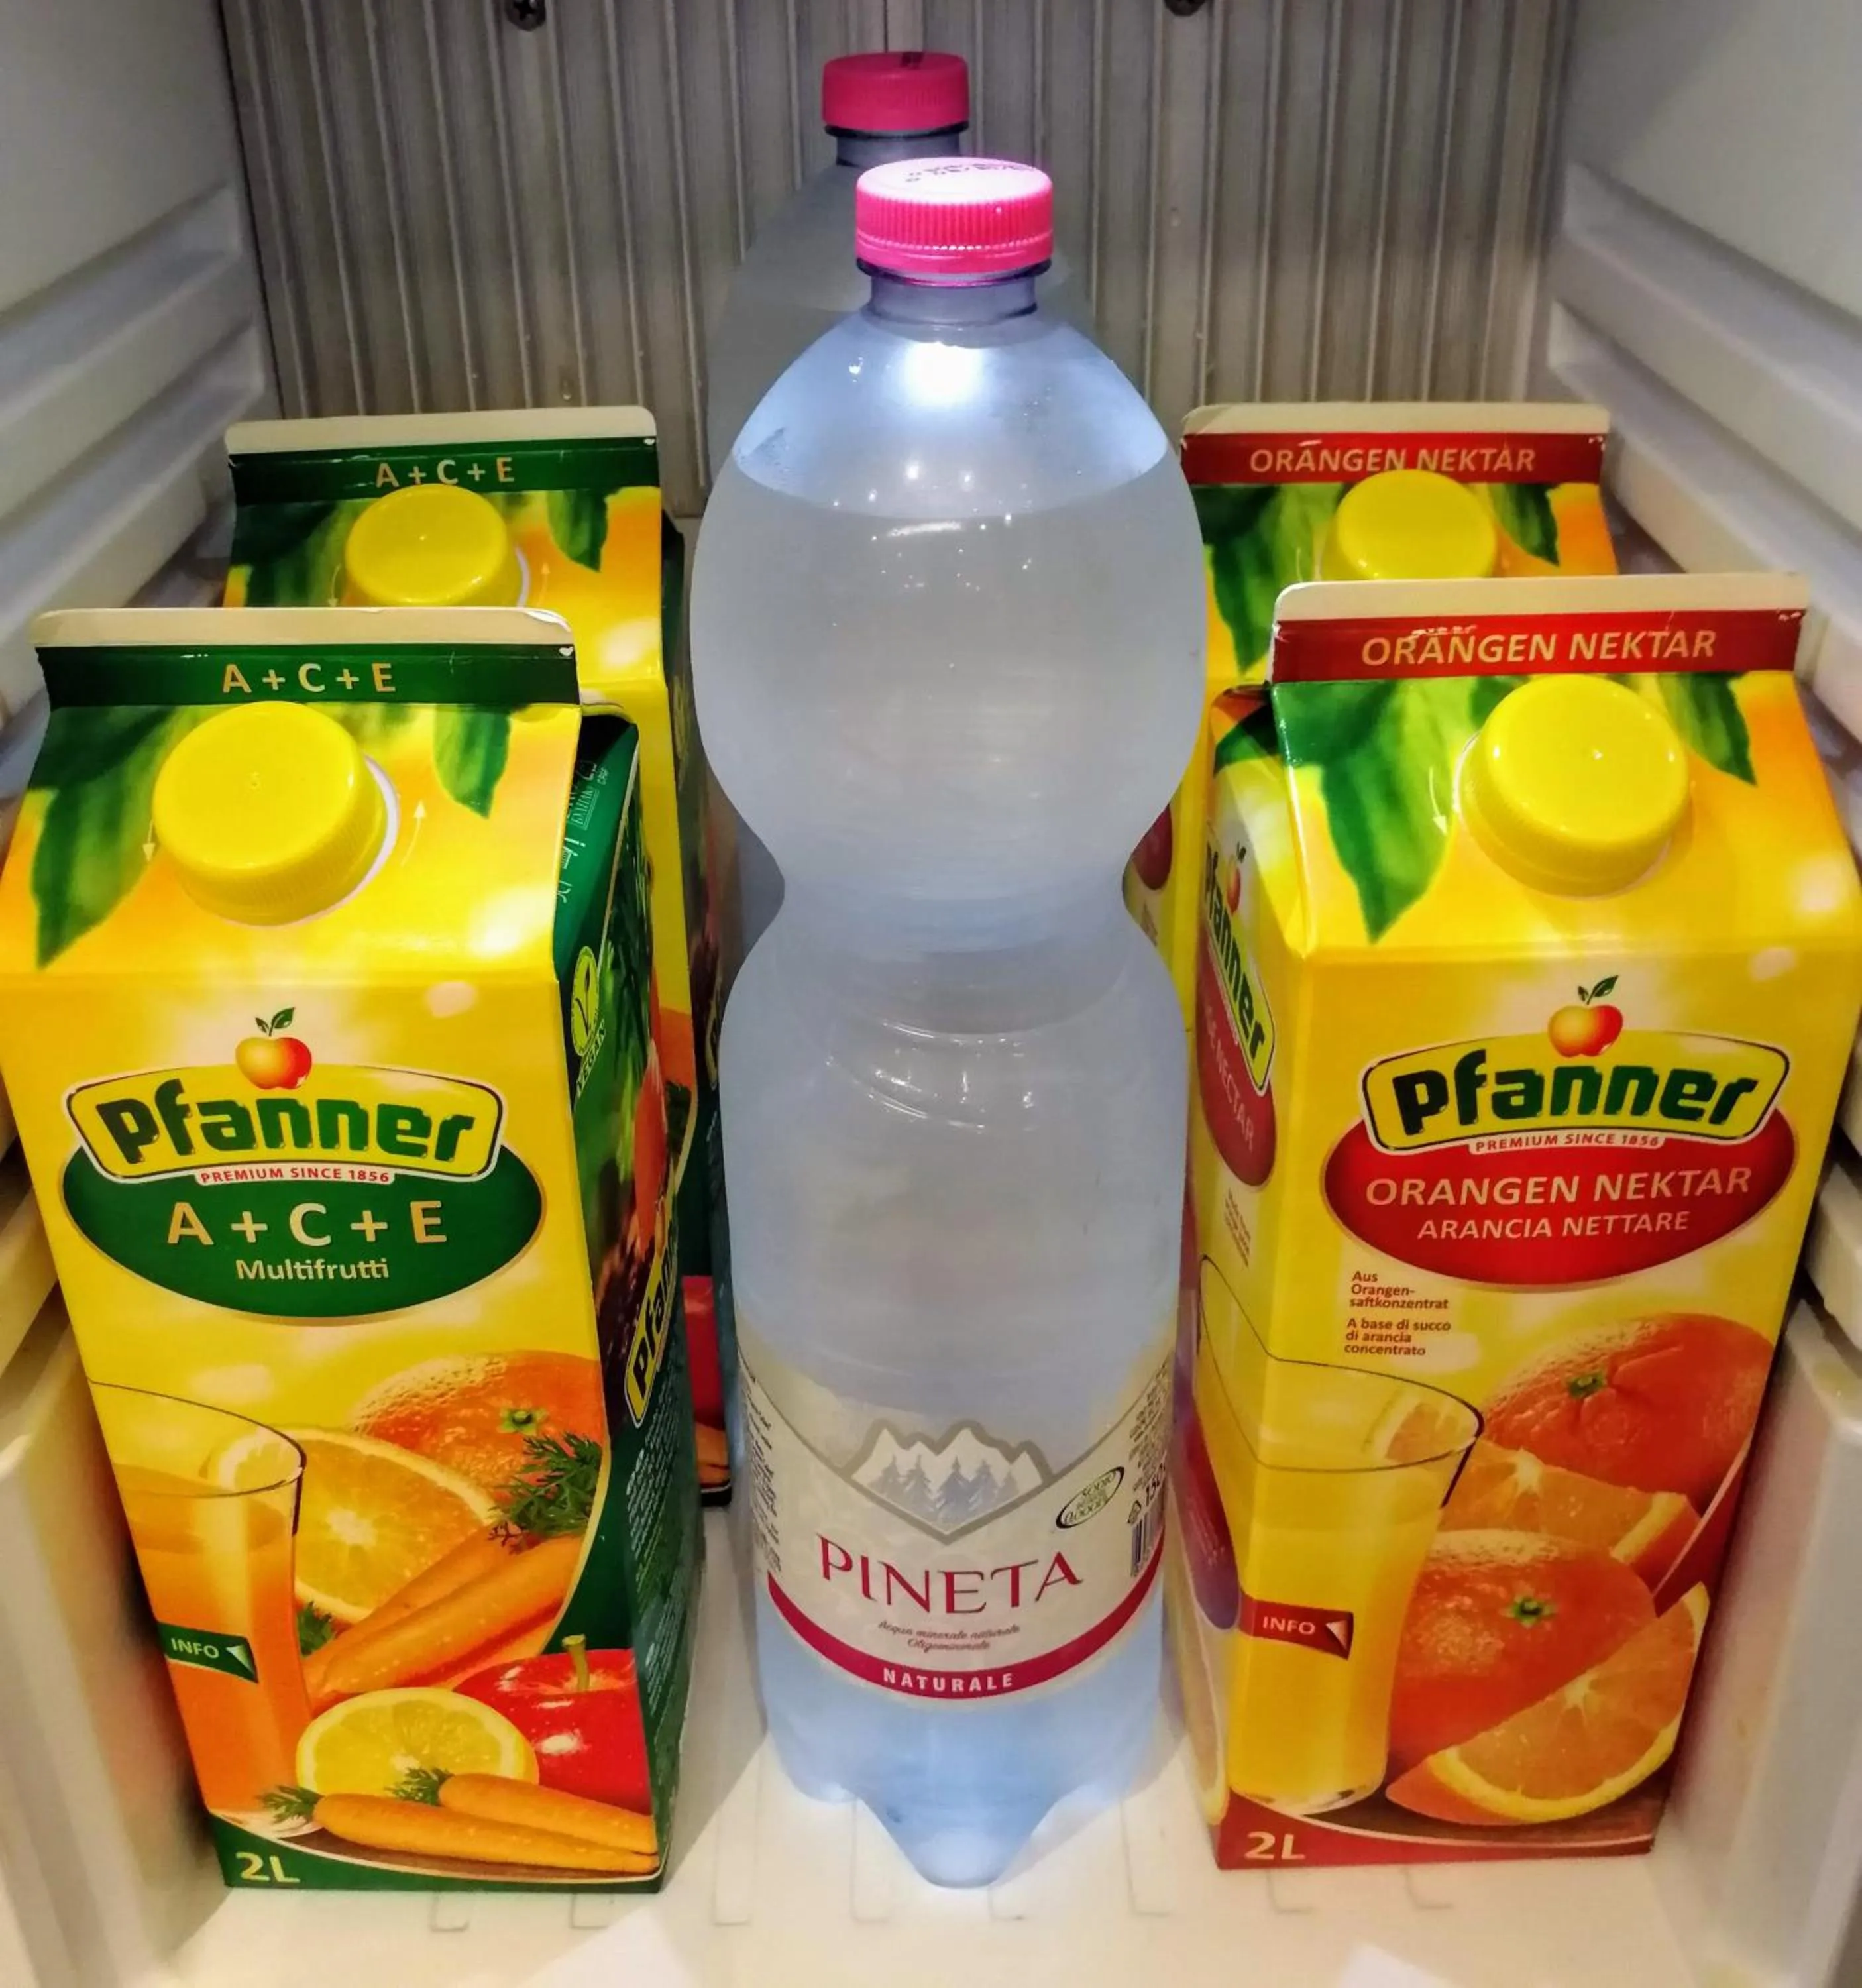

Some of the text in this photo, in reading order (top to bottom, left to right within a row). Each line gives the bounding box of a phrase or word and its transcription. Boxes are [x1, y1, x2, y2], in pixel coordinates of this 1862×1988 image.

[1250, 448, 1536, 472] ORANGEN NEKTAR
[1362, 629, 1716, 666] ORANGEN NEKTAR
[1392, 1048, 1759, 1136] Pfanner
[95, 1077, 476, 1165] Pfanner
[1476, 1133, 1660, 1152] PREMIUM SINCE 1856
[201, 1168, 390, 1183] PREMIUM SINCE 1856
[1366, 1166, 1752, 1206] ORANGEN NEKTAR
[1417, 1210, 1690, 1240] ARANCIA NETTARE
[235, 1258, 390, 1280] Multifrutti
[1352, 1270, 1378, 1282] Aus
[1351, 1283, 1415, 1299] Orangen-
[1349, 1297, 1449, 1309] saftkonzentrat
[1346, 1317, 1452, 1331] A base di succo
[1346, 1330, 1412, 1343] di arancia
[1344, 1344, 1427, 1356] concentrato
[816, 1533, 1083, 1614] PINETA
[1262, 1616, 1316, 1635] INFO
[171, 1637, 220, 1658] INFO
[883, 1667, 1014, 1693] NATURALE
[1245, 1832, 1306, 1861] 2L
[235, 1851, 301, 1883] 2L
